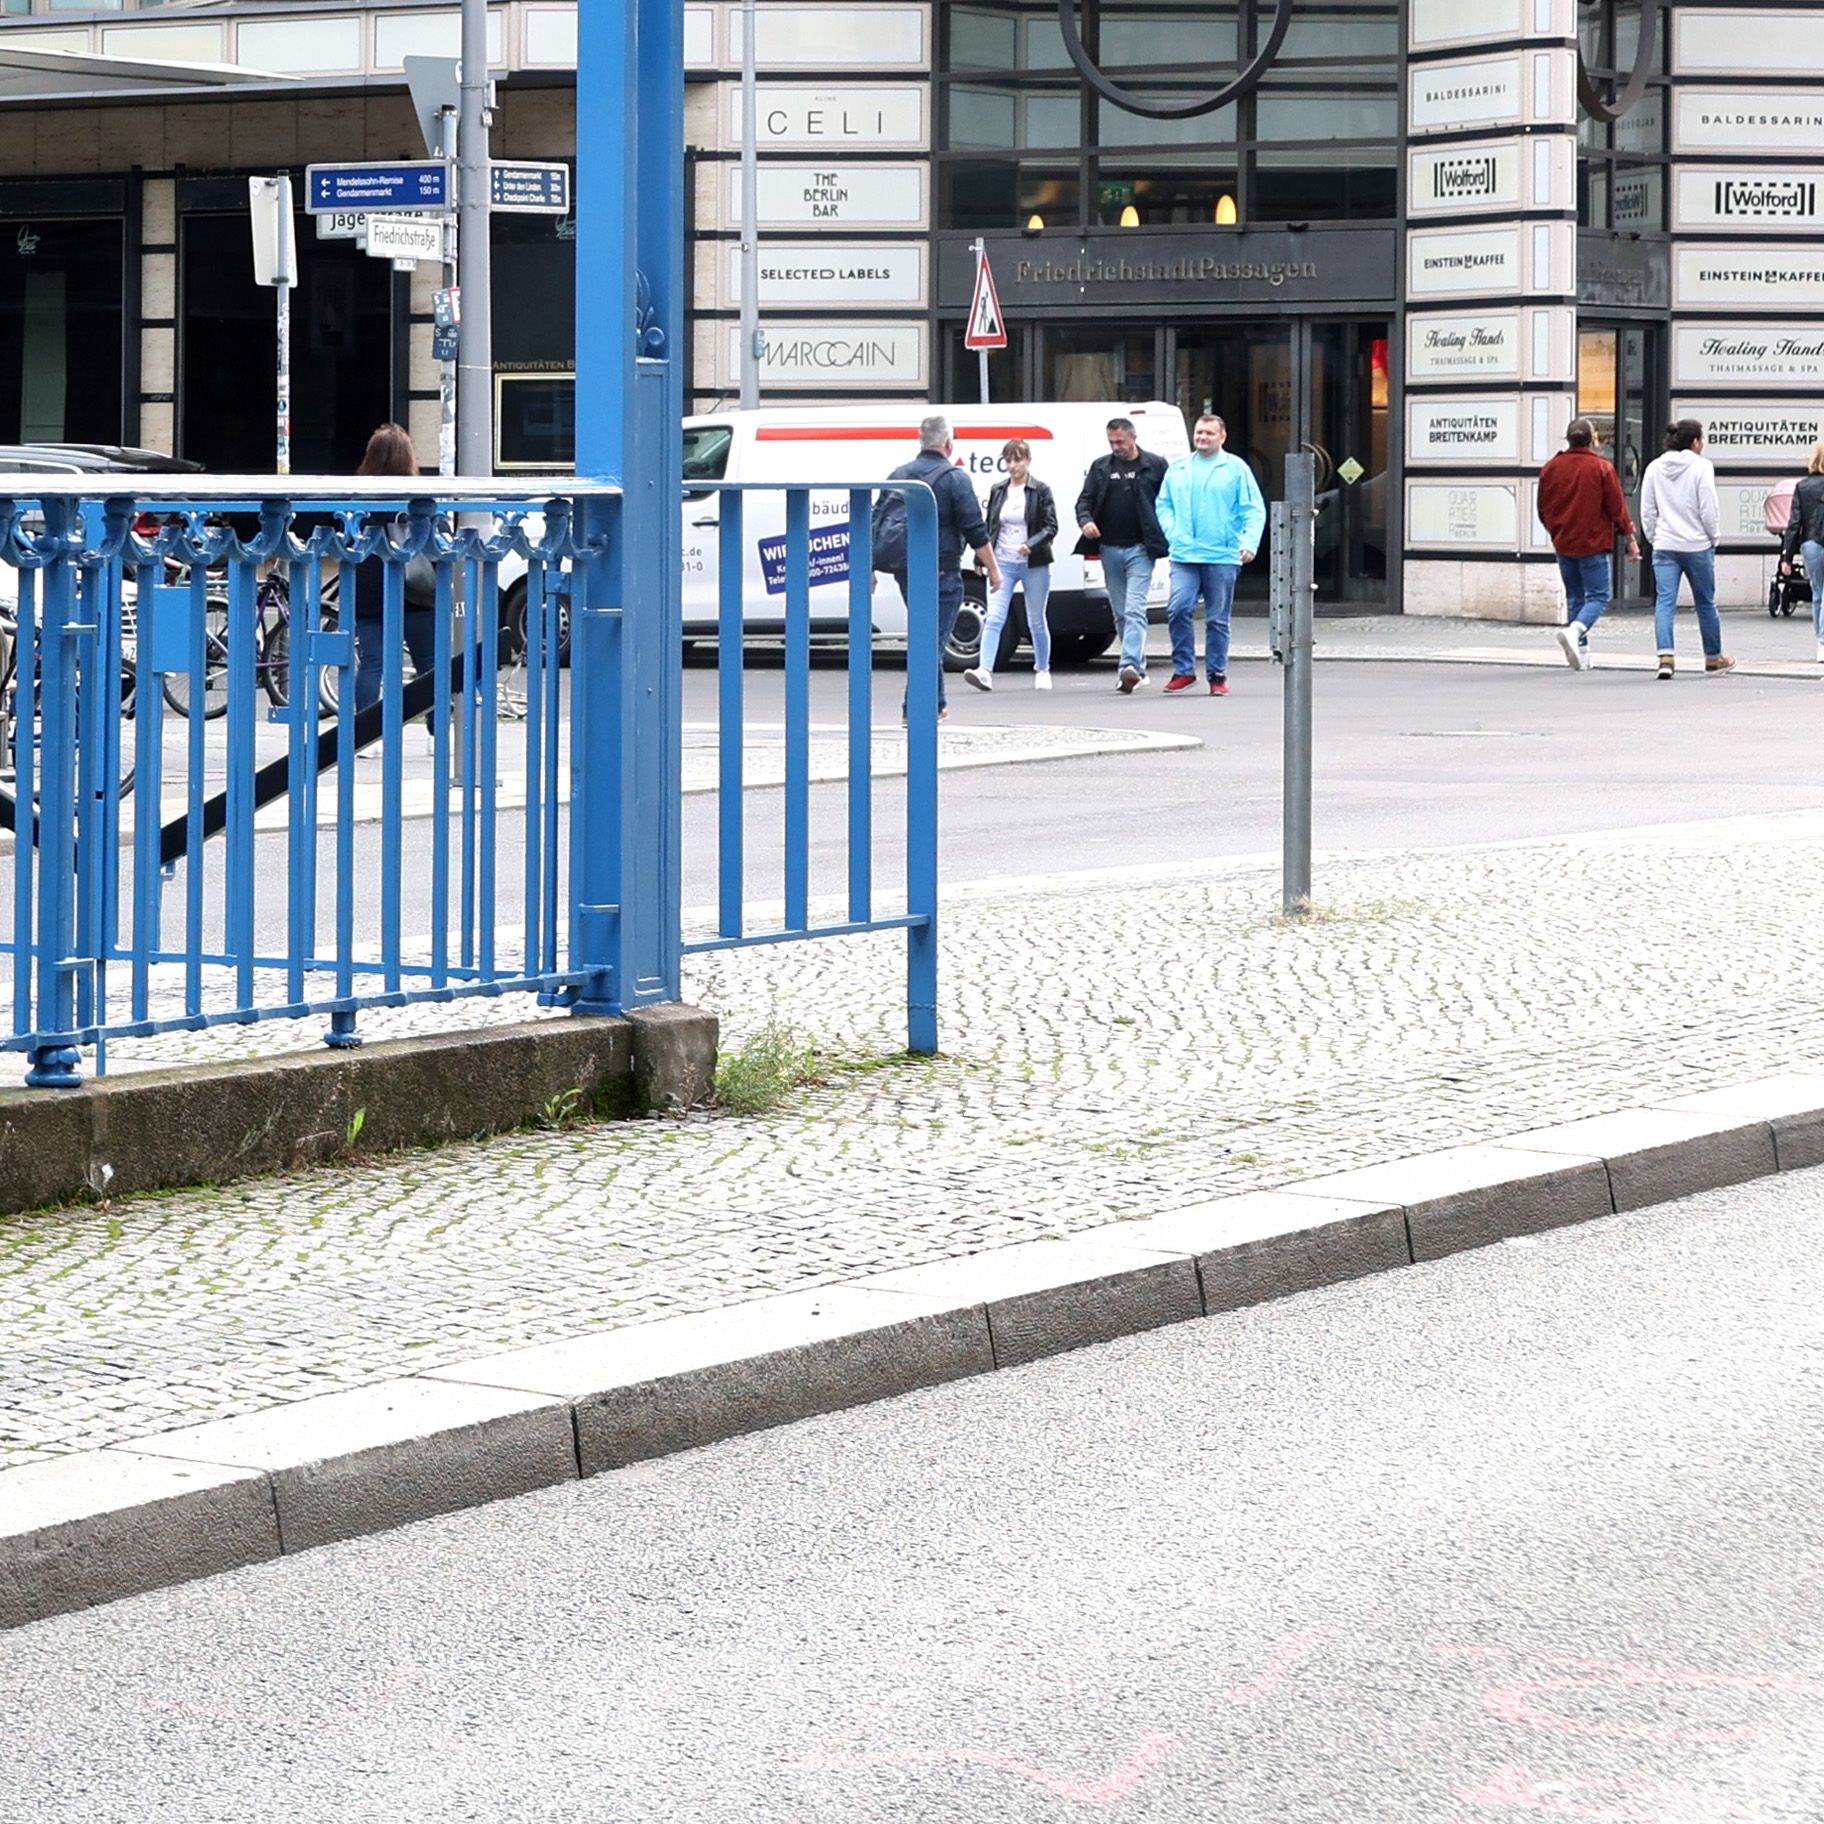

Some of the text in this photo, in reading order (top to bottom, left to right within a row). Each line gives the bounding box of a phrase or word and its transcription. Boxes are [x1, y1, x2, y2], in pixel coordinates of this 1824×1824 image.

[1426, 84, 1506, 102] BALDESSARINI
[767, 110, 883, 135] CELI
[1701, 114, 1824, 126] BALDESSARIN
[418, 174, 432, 183] 400
[814, 173, 838, 186] THE
[1444, 167, 1485, 188] Wolford
[336, 188, 392, 198] Gendarmenmarkt
[803, 188, 848, 202] BERLIN
[1732, 189, 1798, 208] Wolford
[812, 204, 839, 217] BAR
[374, 225, 436, 250] Friedrichstraße
[1424, 254, 1505, 269] EINSTEIN KAFFEE
[761, 269, 890, 279] SELECTED LABELS
[1699, 270, 1762, 282] EINSTEIN
[1424, 327, 1504, 352] Healing Hands
[1699, 338, 1768, 361] Healing
[493, 359, 564, 370] ANTIQUITÄTEN
[1430, 356, 1476, 366] THAIMASSAGE
[1487, 356, 1498, 365] SPA
[1710, 364, 1818, 373] THAIMASSAGE & SPA
[1429, 415, 1497, 429] ANTIQUITÄTEN
[1708, 419, 1818, 432] ANTIQUITÄTEN
[1429, 431, 1497, 443] BREITENKAMP
[1708, 434, 1818, 445] BREITENKAMP
